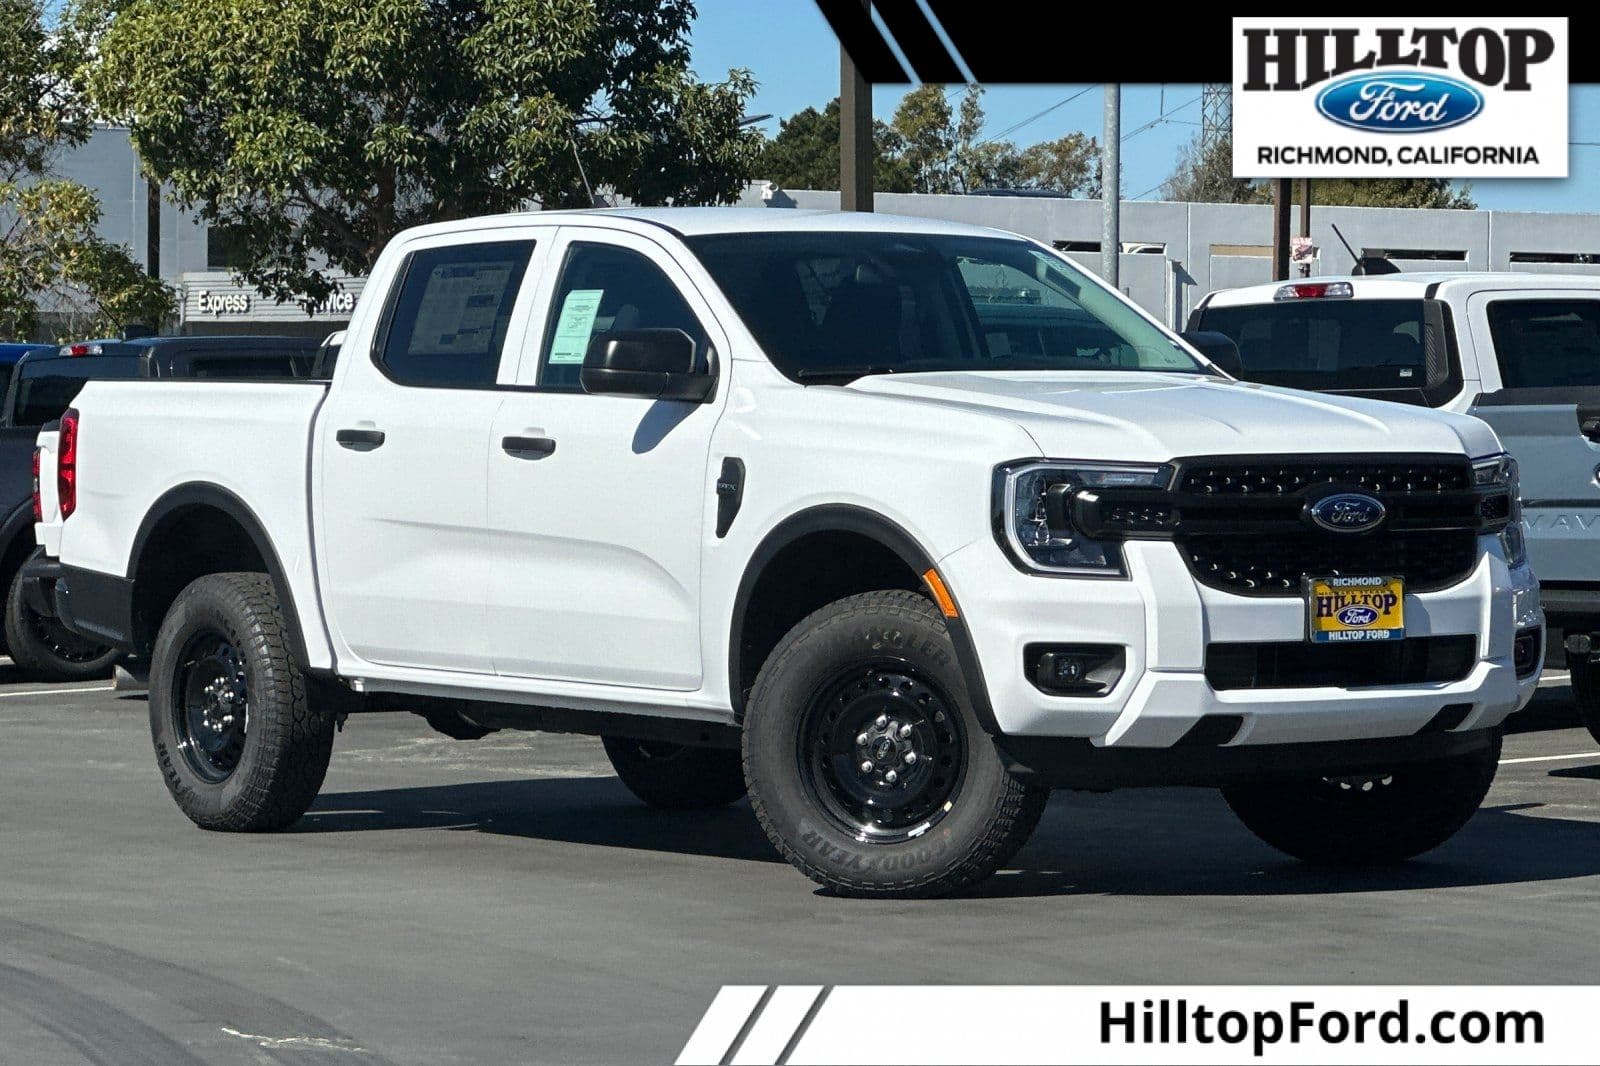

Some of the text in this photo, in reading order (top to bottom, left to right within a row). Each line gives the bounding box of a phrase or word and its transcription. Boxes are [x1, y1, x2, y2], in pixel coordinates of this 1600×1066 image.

[198, 290, 353, 315] Express vice
[1331, 501, 1371, 523] Ford
[1332, 577, 1382, 587] RICHMOND
[1316, 594, 1398, 618] HILLTOP
[1344, 608, 1372, 625] Ford
[1328, 629, 1390, 641] HILLTOP FORD
